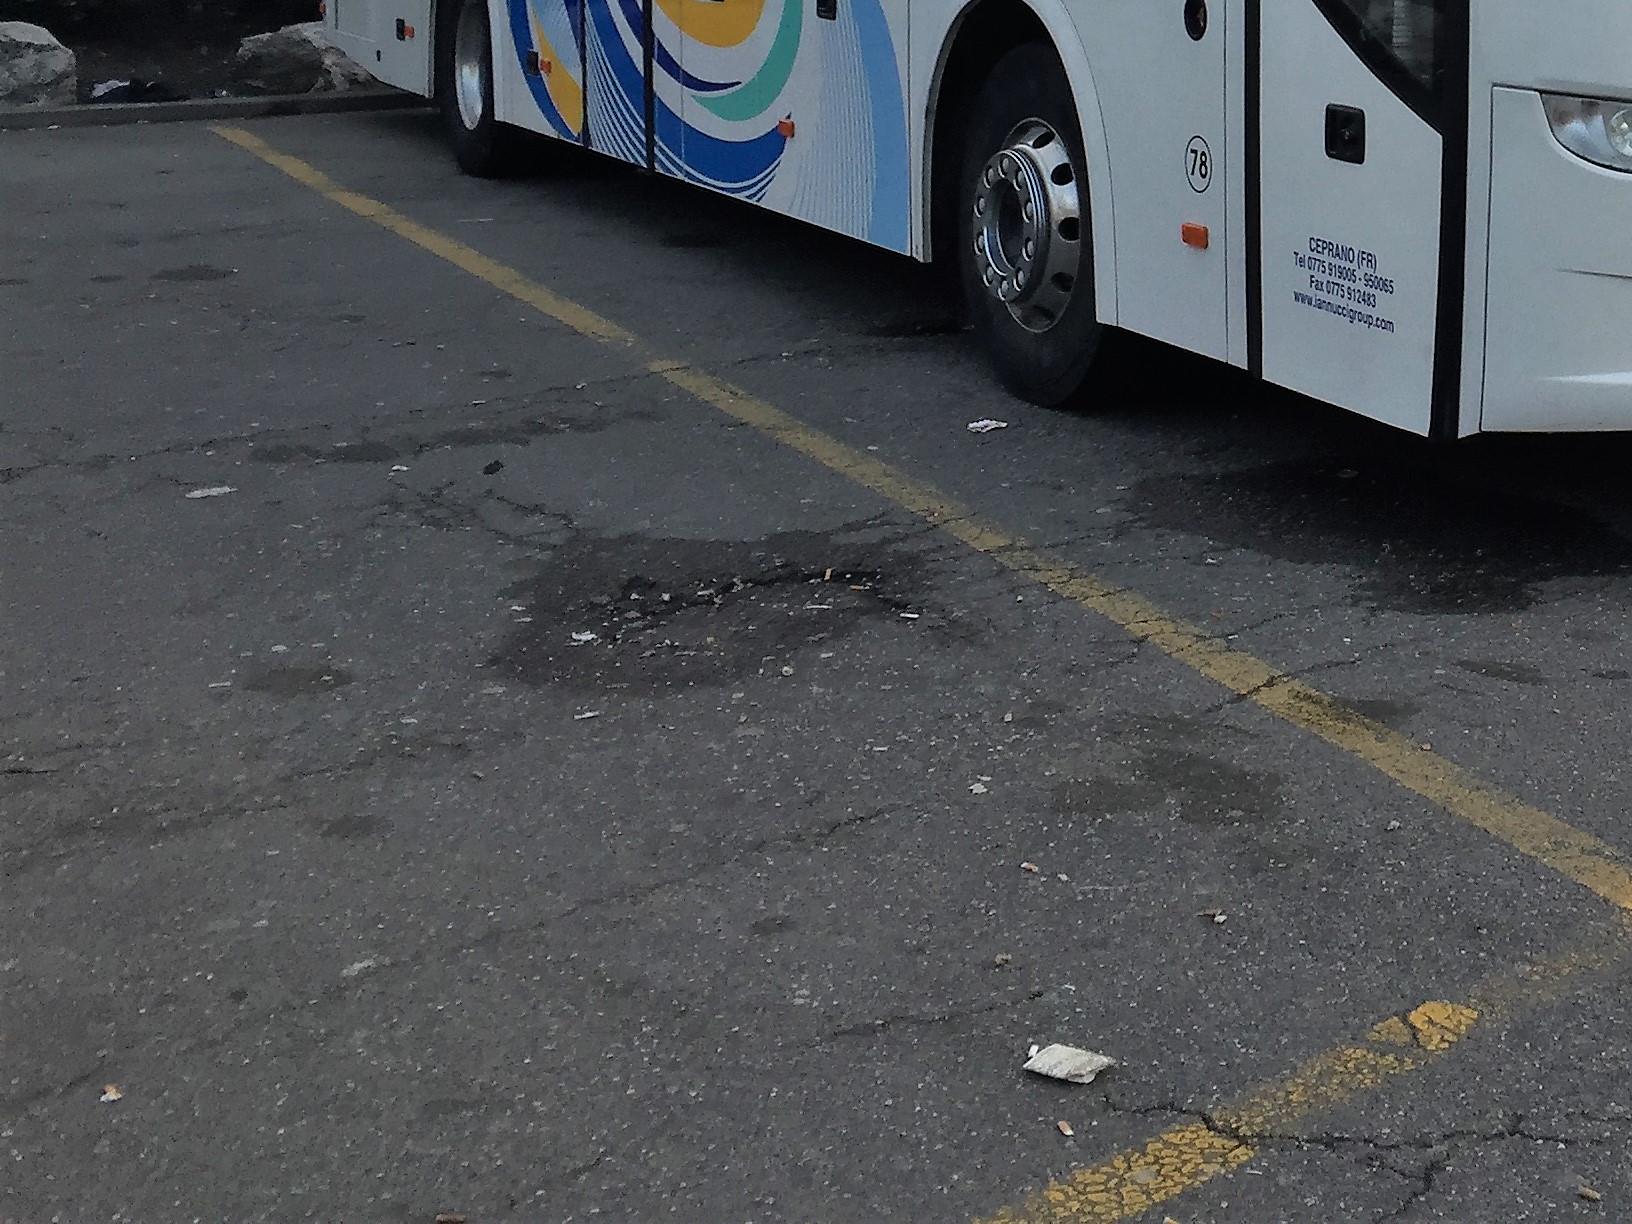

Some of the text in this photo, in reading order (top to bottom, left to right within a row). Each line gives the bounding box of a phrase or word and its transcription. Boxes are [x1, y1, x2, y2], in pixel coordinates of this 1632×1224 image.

[1190, 148, 1208, 179] 78
[1293, 251, 1306, 269] Tel
[1307, 256, 1327, 274] 0775
[1328, 262, 1357, 284] 919005
[1363, 272, 1394, 295] 950065
[1309, 237, 1377, 274] CEPRANO (FR)
[1309, 274, 1325, 292] Fax
[1326, 280, 1345, 299] 0775
[1293, 290, 1395, 334] www.iannuccigroup.com
